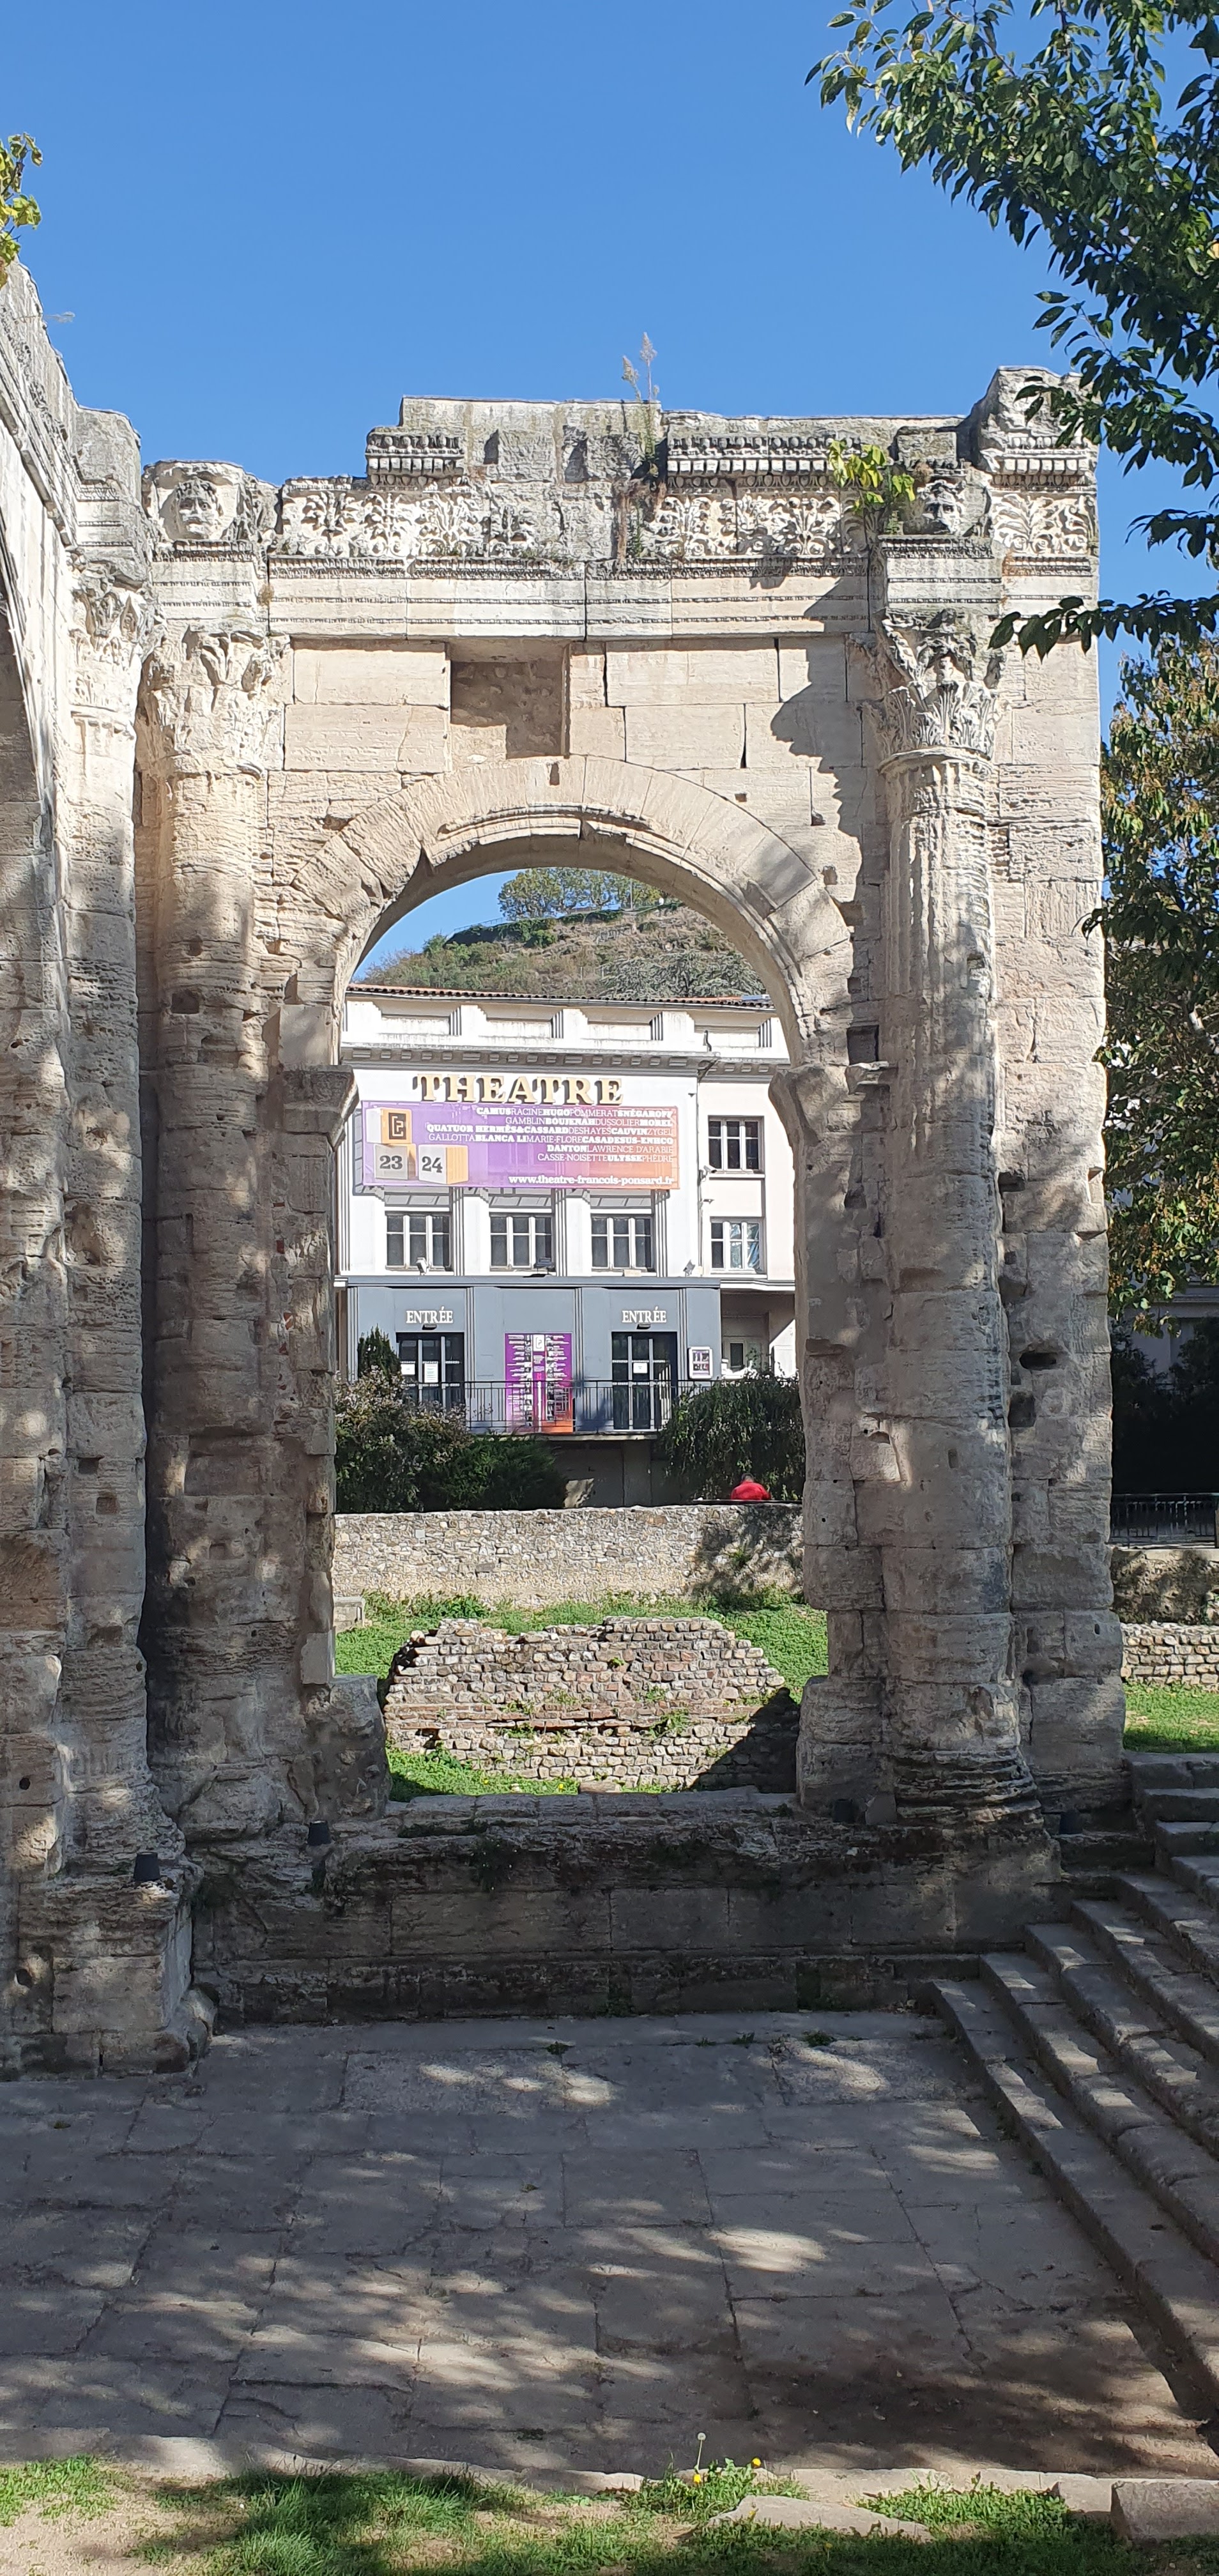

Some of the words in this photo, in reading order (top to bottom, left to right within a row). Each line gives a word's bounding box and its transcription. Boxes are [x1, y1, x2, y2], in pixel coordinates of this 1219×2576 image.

[417, 1073, 624, 1105] THEATRE
[426, 1124, 474, 1133] QUATUOR
[379, 1155, 403, 1170] 23
[421, 1156, 443, 1173] 24
[508, 1175, 675, 1186] www.theatre-francois-ponsard.fr
[406, 1306, 454, 1324] ENTRÉE
[622, 1306, 667, 1323] ENTRÉE
